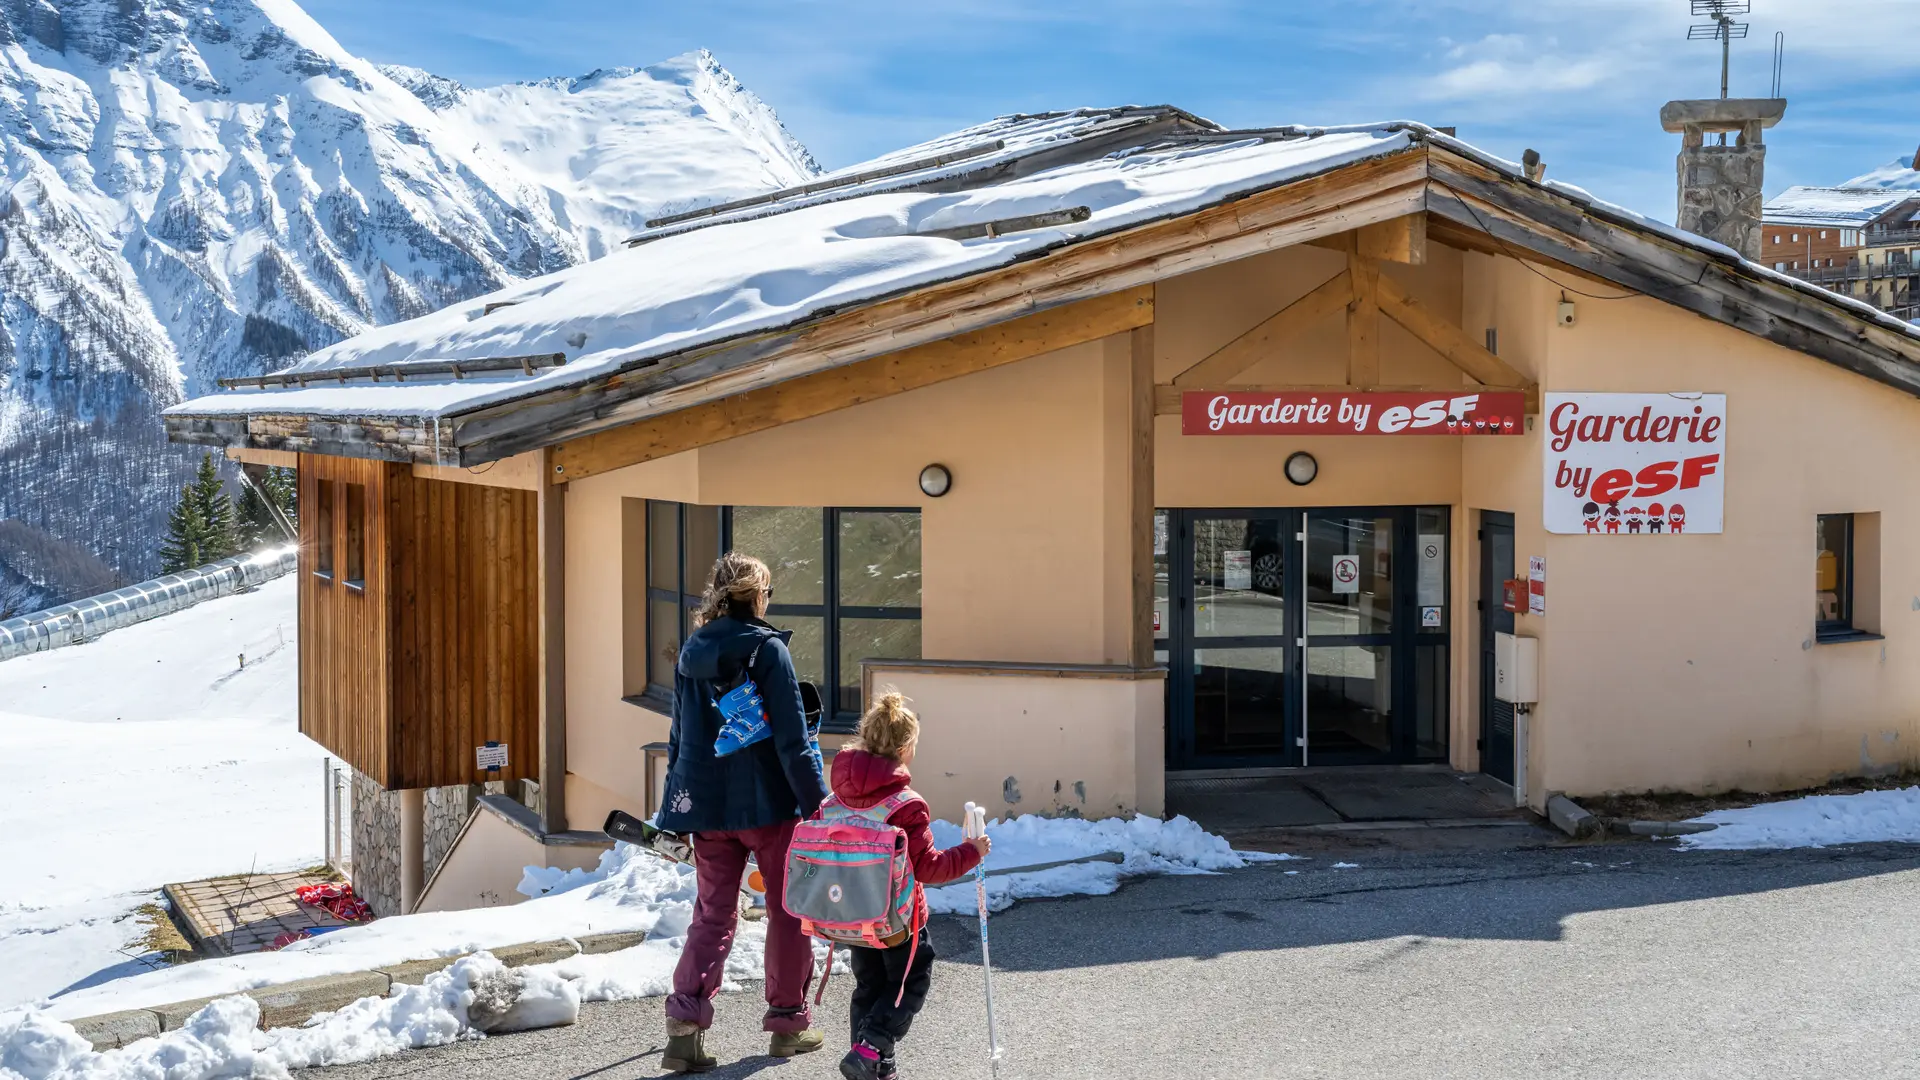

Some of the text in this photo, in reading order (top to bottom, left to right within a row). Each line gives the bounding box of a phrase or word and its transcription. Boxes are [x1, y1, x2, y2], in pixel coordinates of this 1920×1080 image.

[1208, 395, 1332, 431] Garderie
[1337, 397, 1372, 432] by
[1550, 402, 1721, 452] Garderie
[1555, 460, 1592, 498] by
